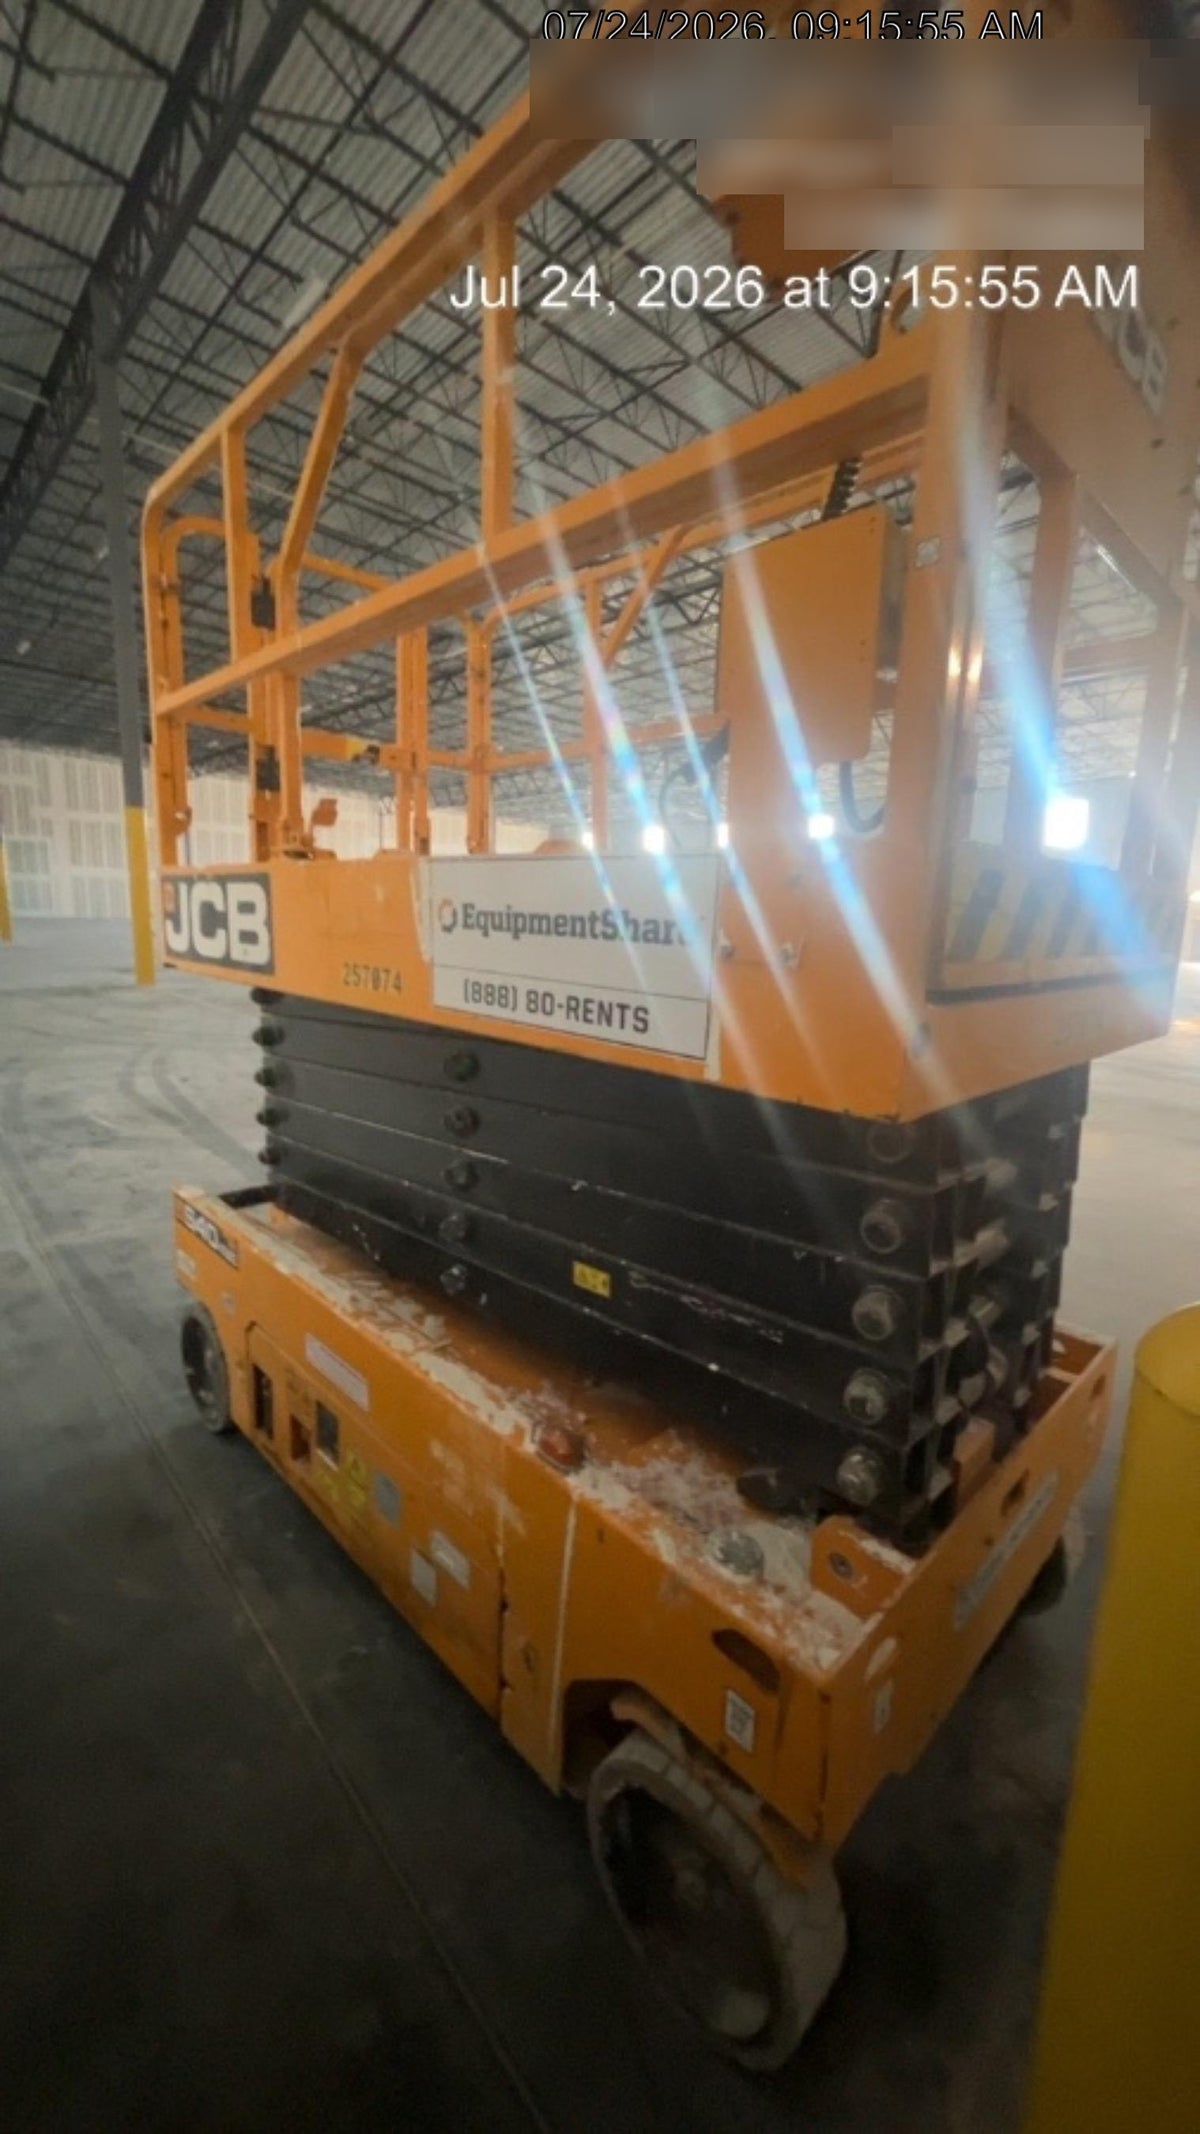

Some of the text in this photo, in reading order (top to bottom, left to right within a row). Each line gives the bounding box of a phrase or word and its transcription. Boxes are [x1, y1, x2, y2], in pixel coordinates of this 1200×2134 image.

[165, 880, 271, 966] JCB
[463, 977, 650, 1034] (888) 80-RENTS
